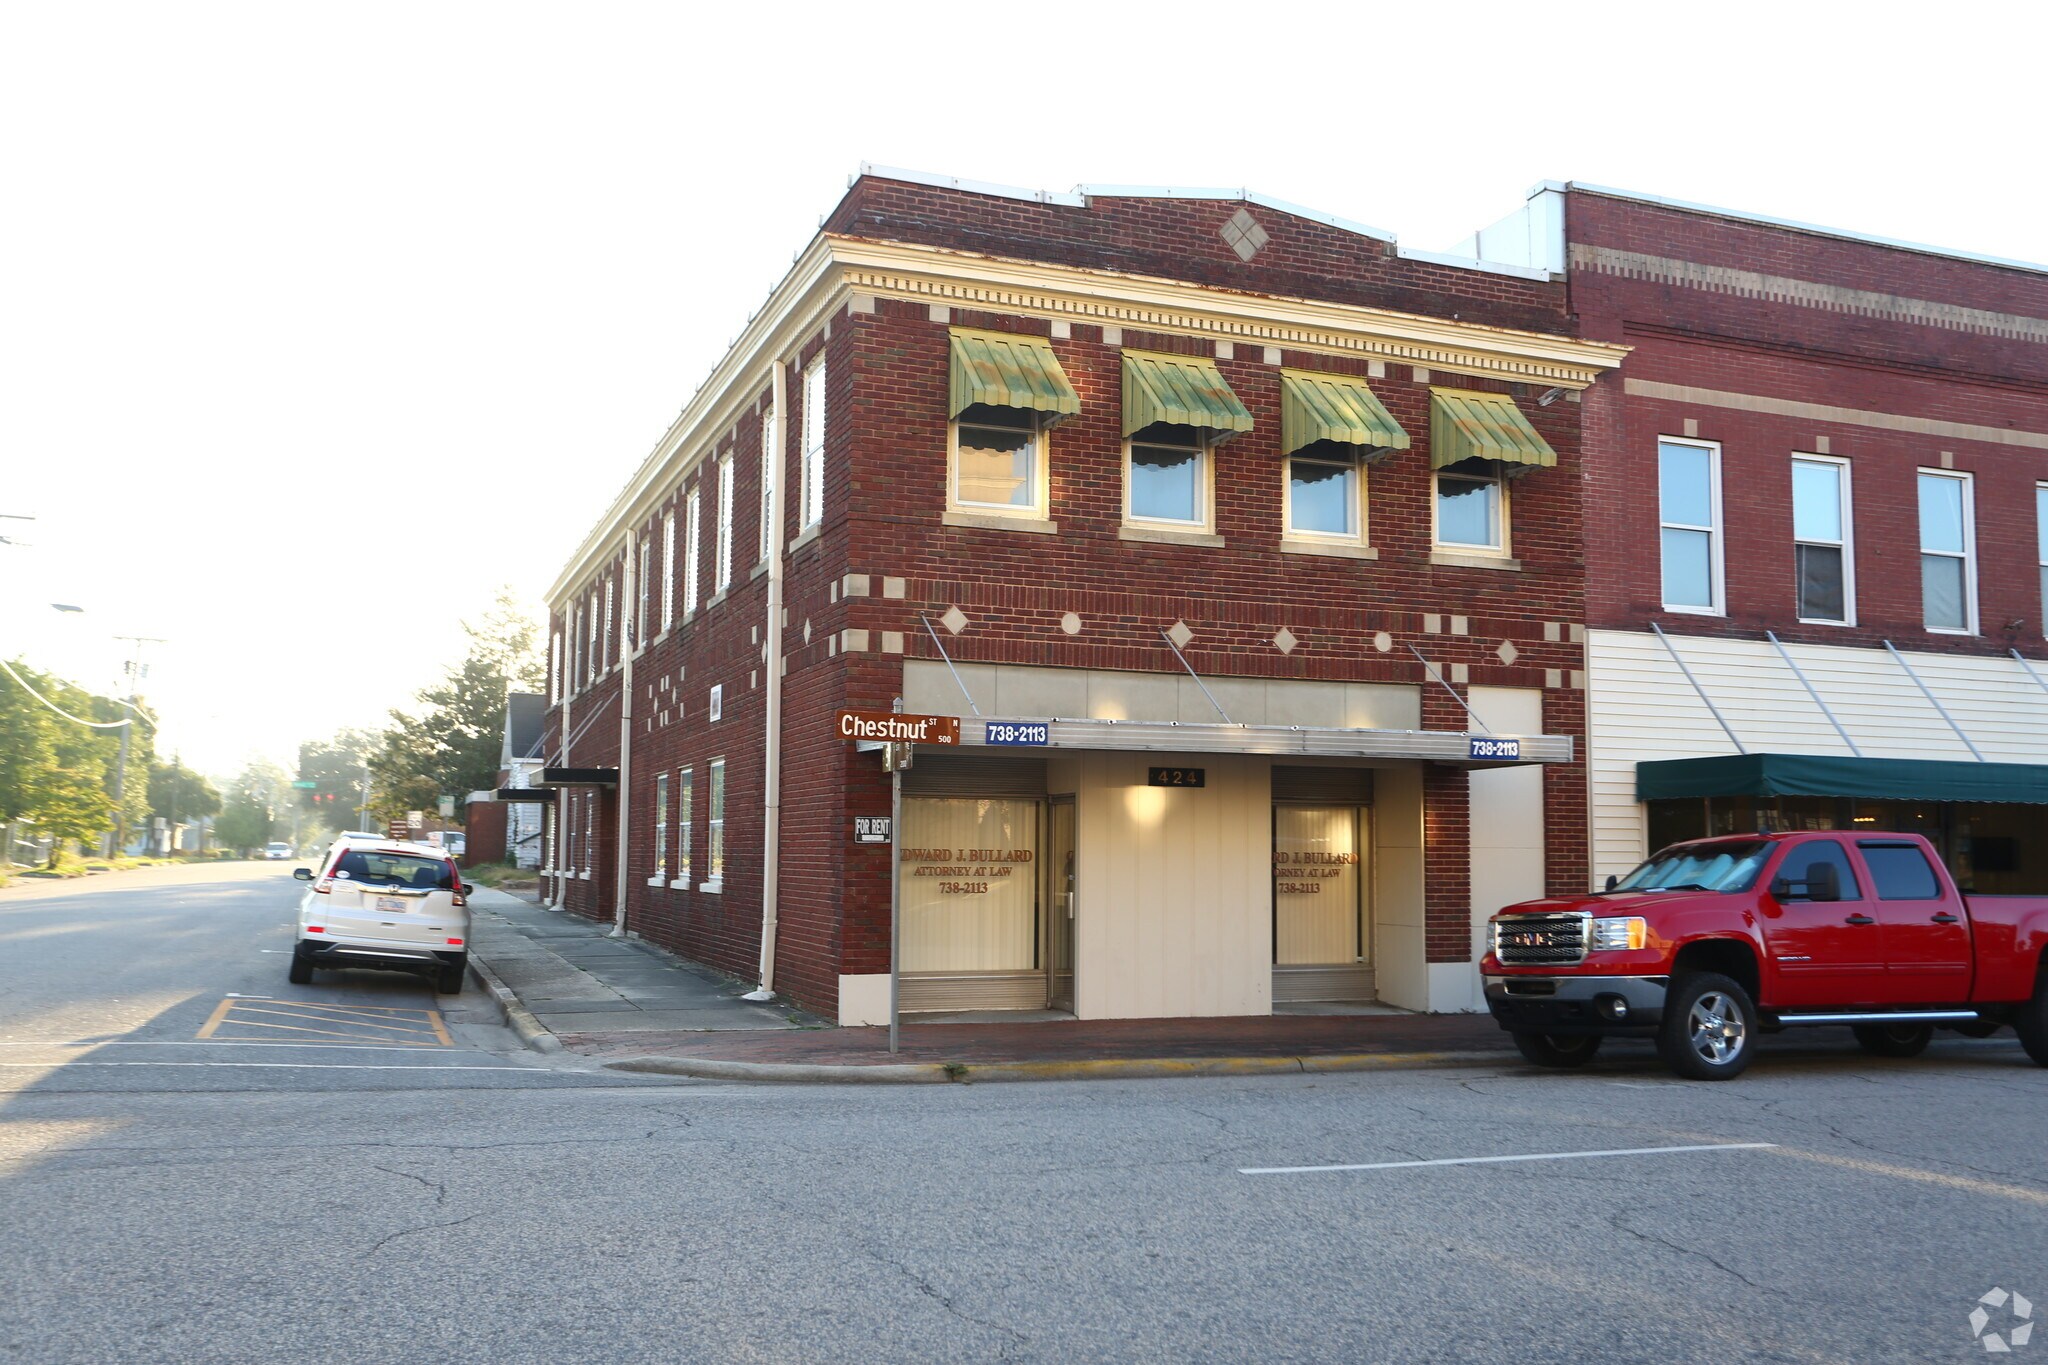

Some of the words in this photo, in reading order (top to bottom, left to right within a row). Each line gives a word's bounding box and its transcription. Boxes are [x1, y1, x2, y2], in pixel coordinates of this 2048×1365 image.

[841, 714, 928, 739] Chestnut
[928, 718, 937, 726] ST
[953, 719, 958, 727] N
[938, 735, 951, 743] 500
[988, 725, 1046, 742] 738-2113
[1472, 741, 1518, 756] 738-2113
[856, 818, 870, 834] FOR
[871, 819, 890, 834] RENT
[956, 849, 967, 862] J.
[969, 849, 1033, 862] BULLARD
[1303, 852, 1359, 865] BULLARD
[914, 866, 971, 876] ATTORNEY
[973, 866, 987, 876] AT
[989, 866, 1013, 876] LAW
[1273, 868, 1306, 877] ORNEY
[1307, 868, 1319, 878] AT
[1321, 868, 1341, 878] LAW
[939, 882, 988, 893] 738-2113
[1278, 883, 1320, 893] 738-2113
